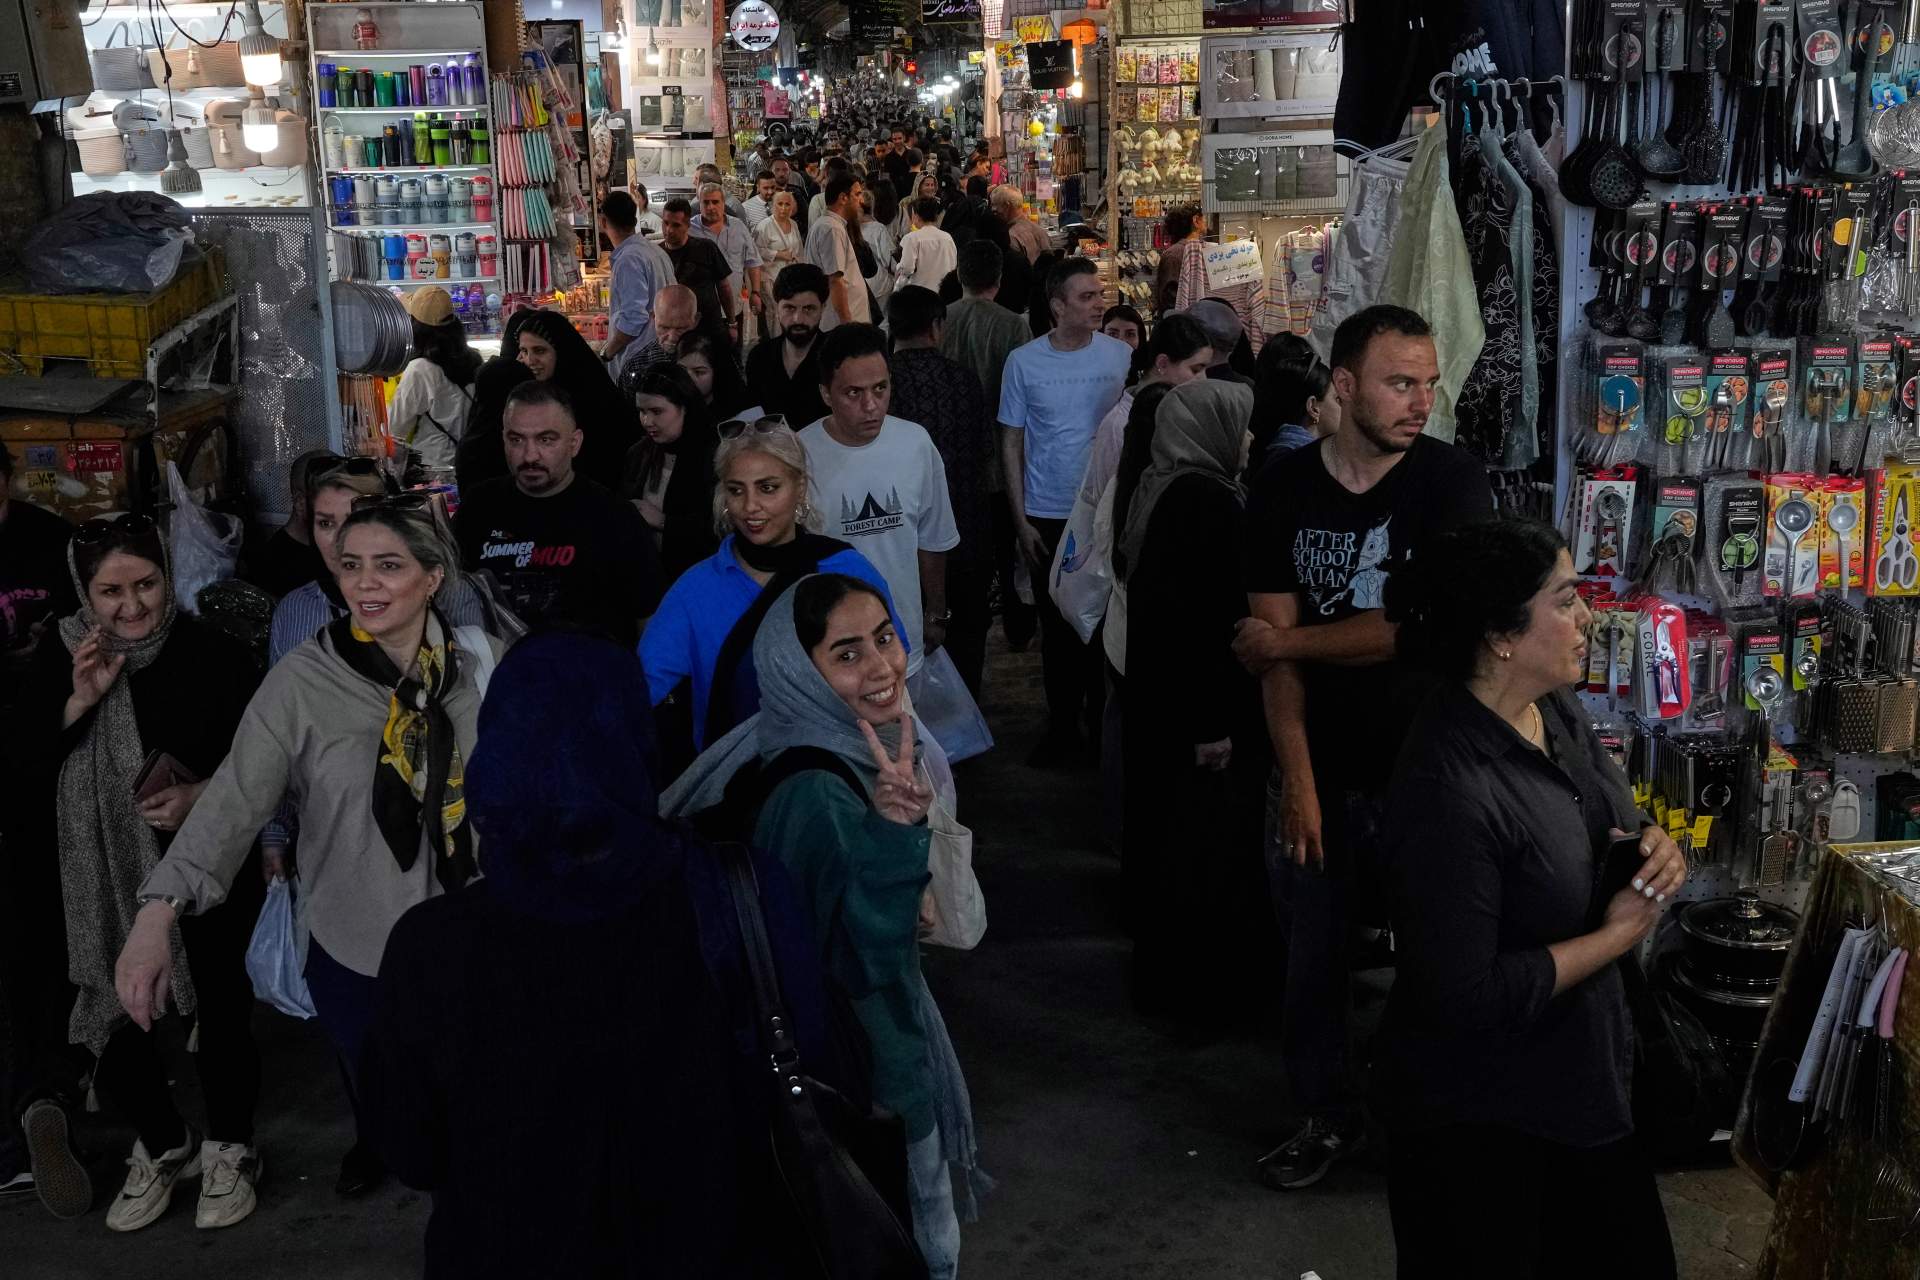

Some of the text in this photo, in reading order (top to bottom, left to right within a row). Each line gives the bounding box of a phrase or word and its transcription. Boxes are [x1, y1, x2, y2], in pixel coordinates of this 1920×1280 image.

[731, 21, 748, 31] ایران
[845, 516, 902, 533] FOREST CAMP
[1294, 528, 1358, 553] AFTER
[1292, 548, 1356, 569] SCHOOL
[1296, 565, 1352, 588] SATAN
[1643, 631, 1653, 678] CORAL
